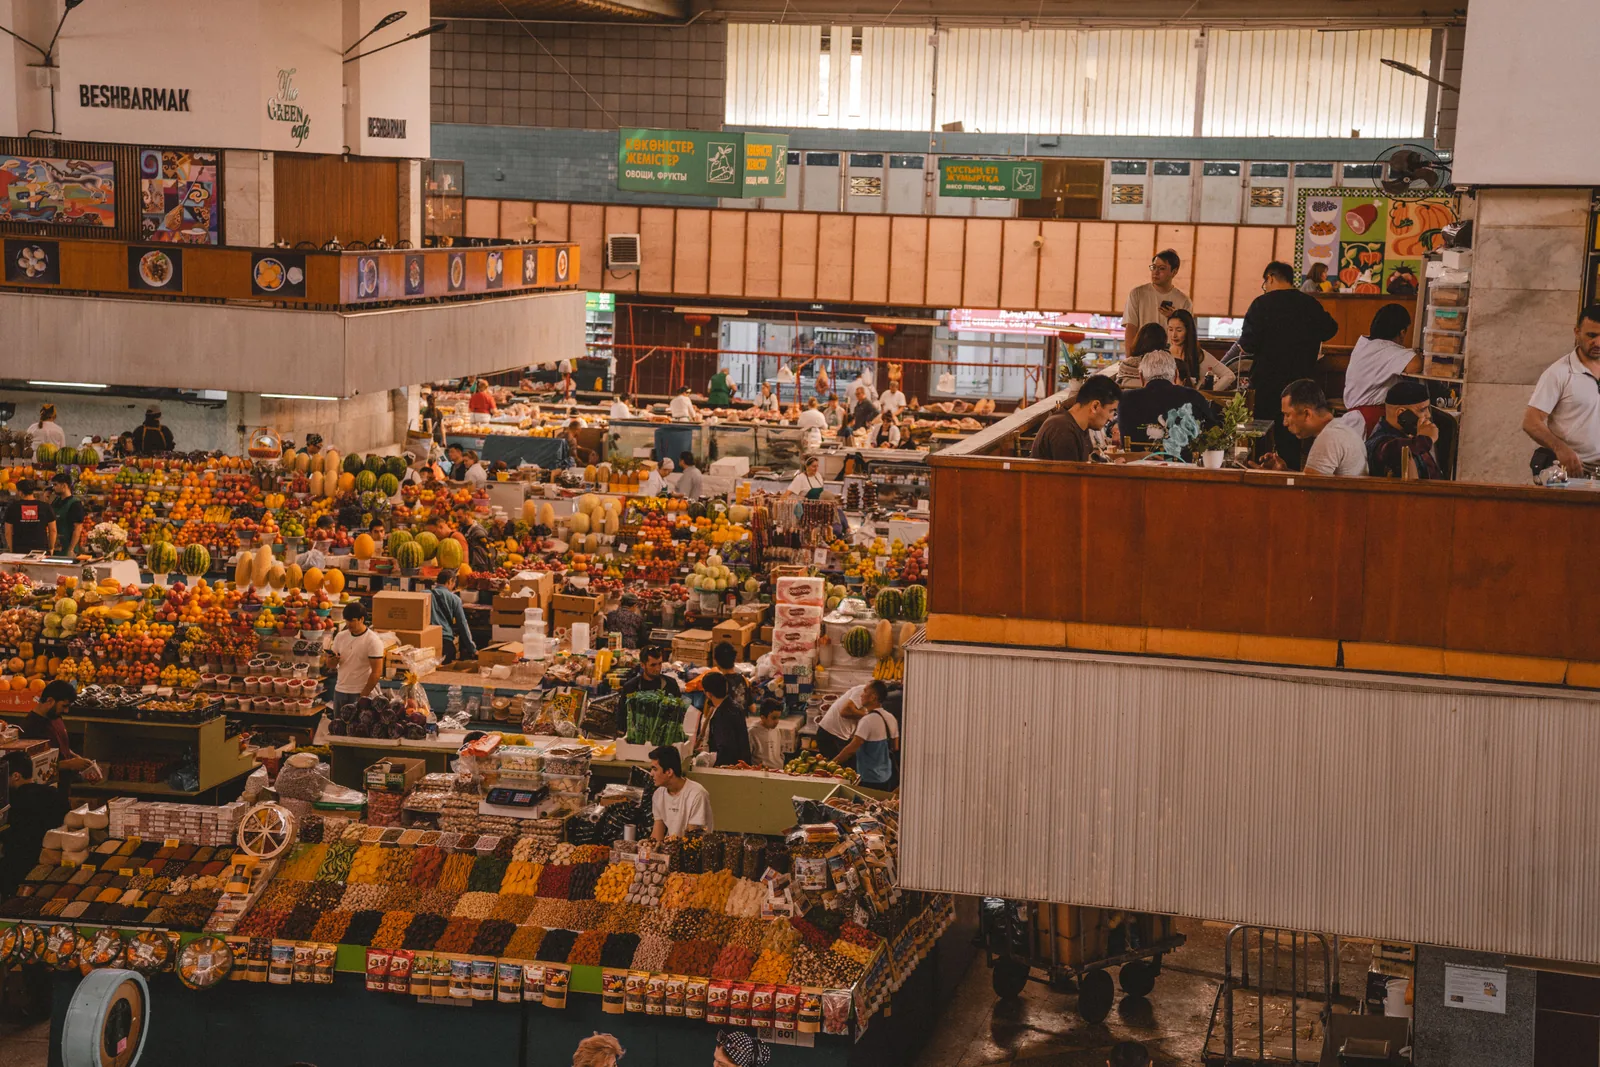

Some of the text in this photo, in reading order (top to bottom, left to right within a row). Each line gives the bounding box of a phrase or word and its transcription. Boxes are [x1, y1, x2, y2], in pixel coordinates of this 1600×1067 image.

[277, 68, 299, 102] The
[79, 84, 190, 112] BESHBARMAK
[267, 97, 304, 123] GREEN
[291, 114, 311, 149] café
[368, 117, 407, 139] BESHBARMAK
[626, 152, 680, 167] ЖЕМІСТЕР
[625, 171, 688, 181] ОВОЩИ, ФРУКТЫ
[778, 1030, 794, 1039] 601
